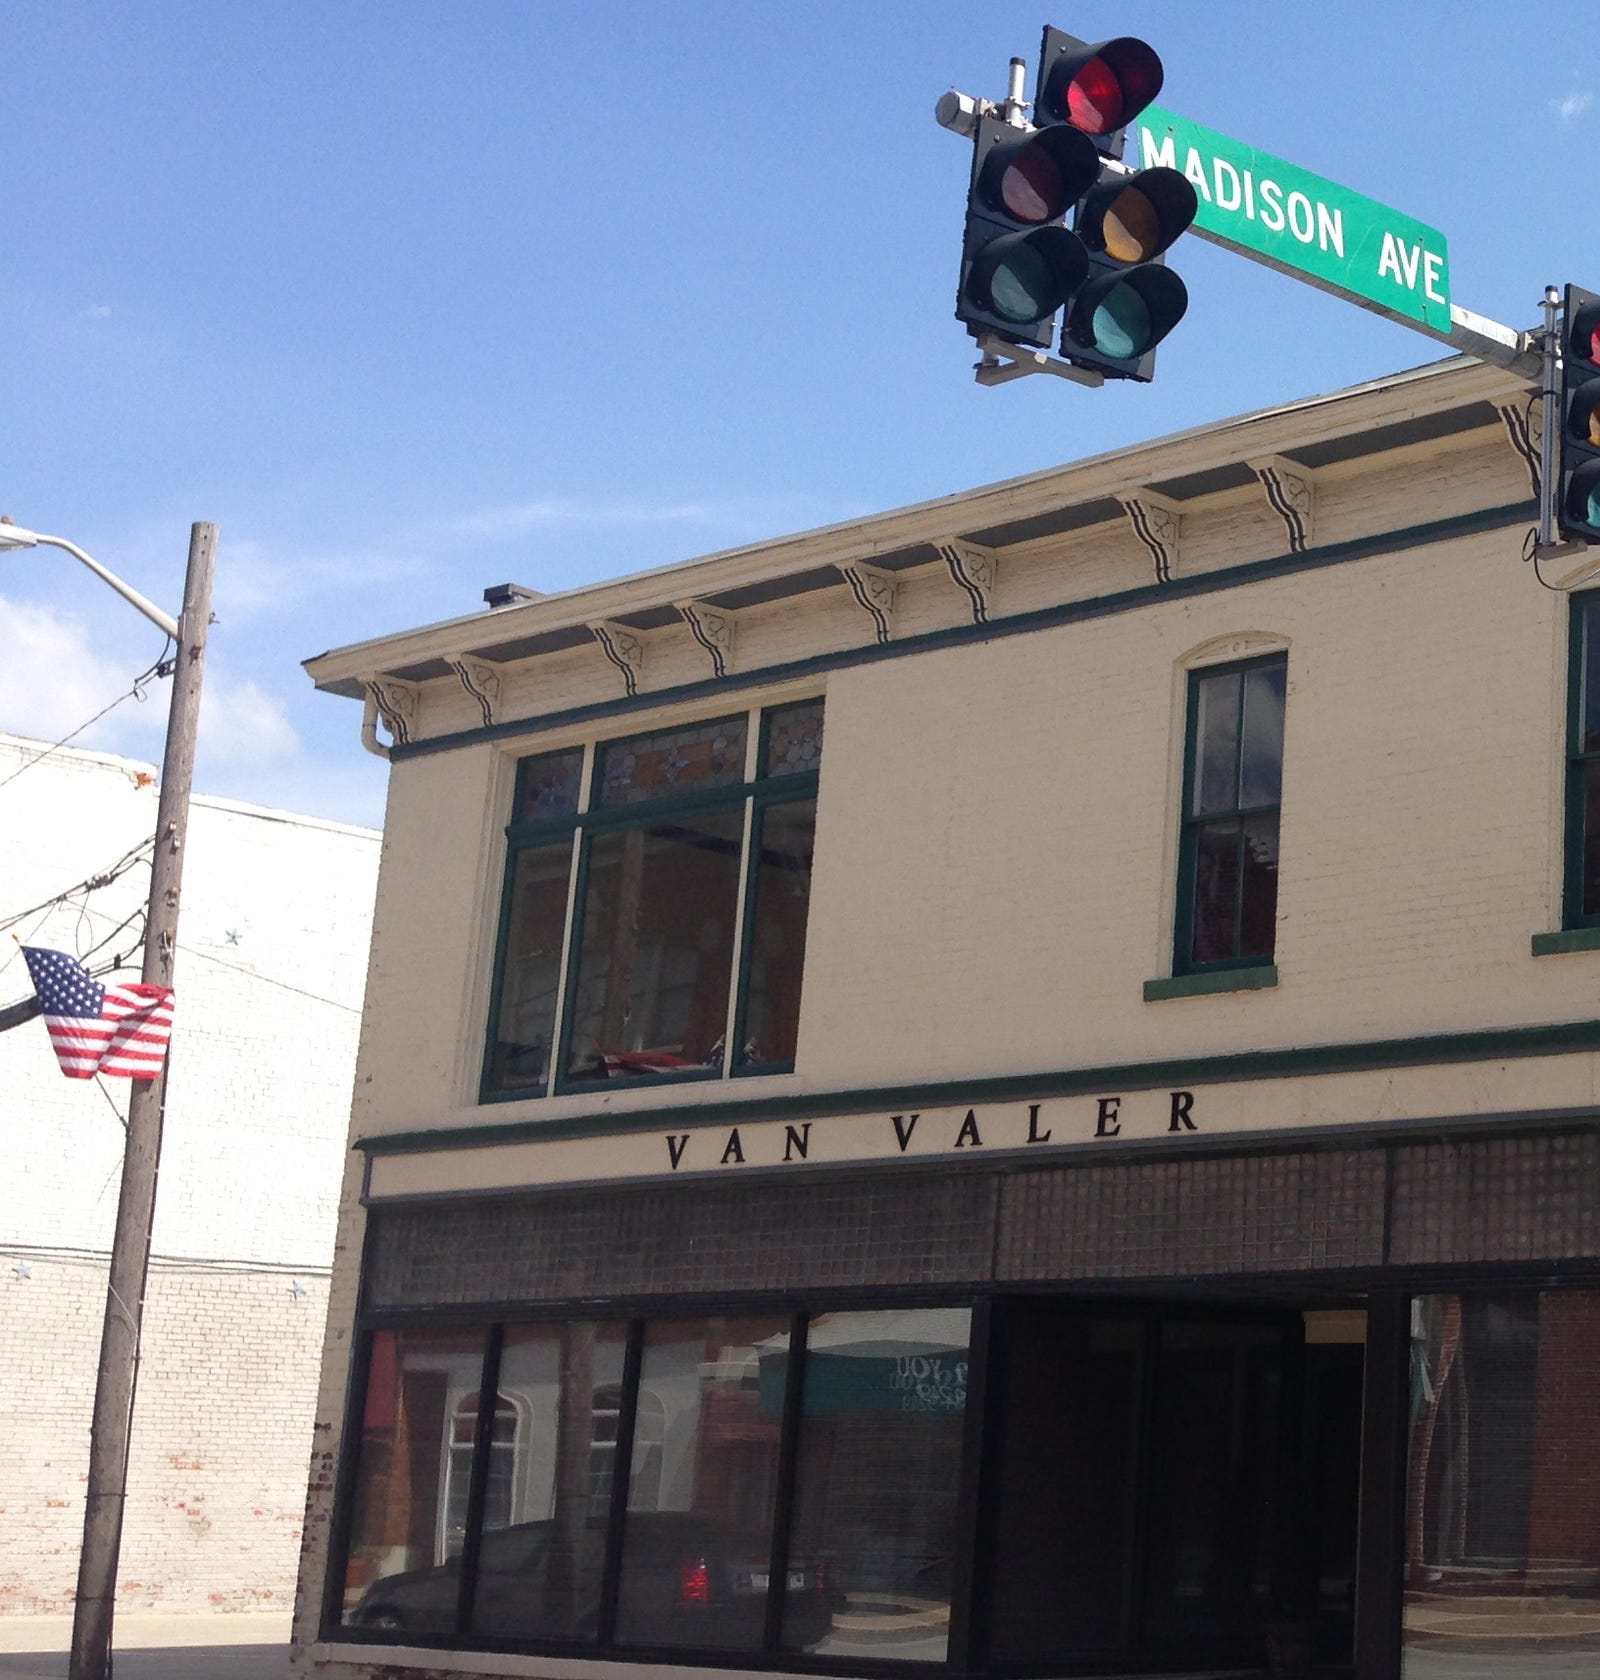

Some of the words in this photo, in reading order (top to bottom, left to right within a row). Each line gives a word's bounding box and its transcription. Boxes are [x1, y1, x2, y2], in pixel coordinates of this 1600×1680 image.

[1141, 126, 1344, 259] MADISON
[1378, 231, 1446, 305] AVE
[666, 1122, 813, 1171] VAN
[890, 1090, 1199, 1152] VALER
